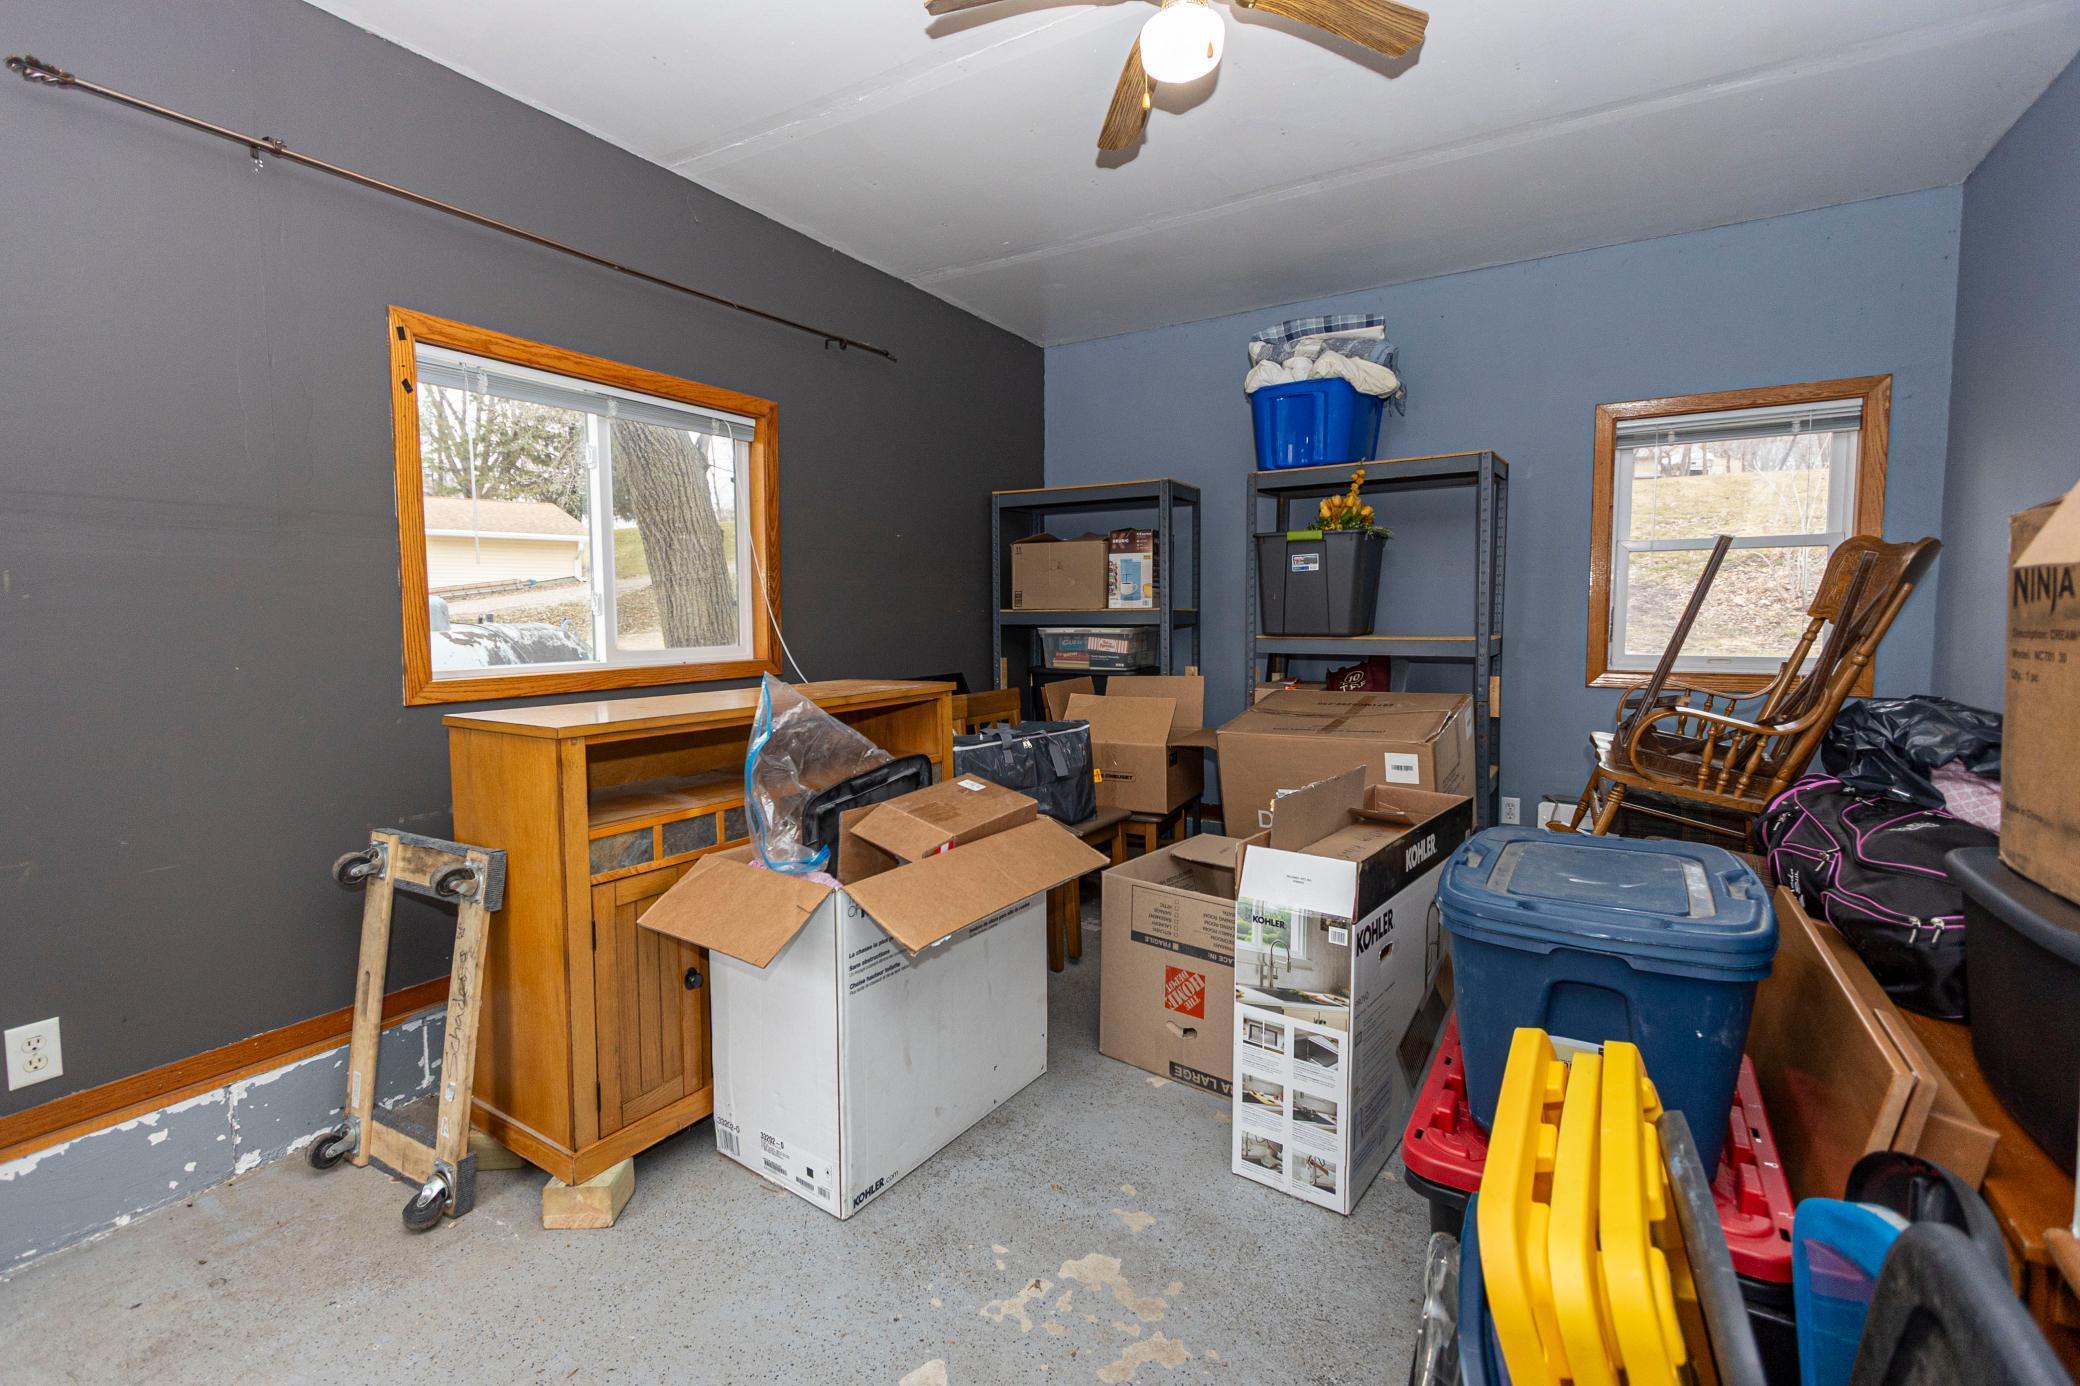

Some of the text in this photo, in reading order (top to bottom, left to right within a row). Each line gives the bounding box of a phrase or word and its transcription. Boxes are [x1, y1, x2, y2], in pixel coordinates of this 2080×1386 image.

[2013, 566, 2075, 616] NINJA
[1405, 833, 1437, 872] KOHLER
[1202, 926, 1217, 934] ROOM
[1252, 915, 1285, 929] KOHLER
[1356, 908, 1394, 957] KOHLER
[1144, 936, 1172, 949] FRAGILE
[1218, 955, 1234, 964] ACE
[1165, 970, 1190, 993] DEPOT
[1167, 974, 1205, 1010] HOME
[1183, 995, 1200, 1011] THE
[1174, 1066, 1217, 1090] LARGE
